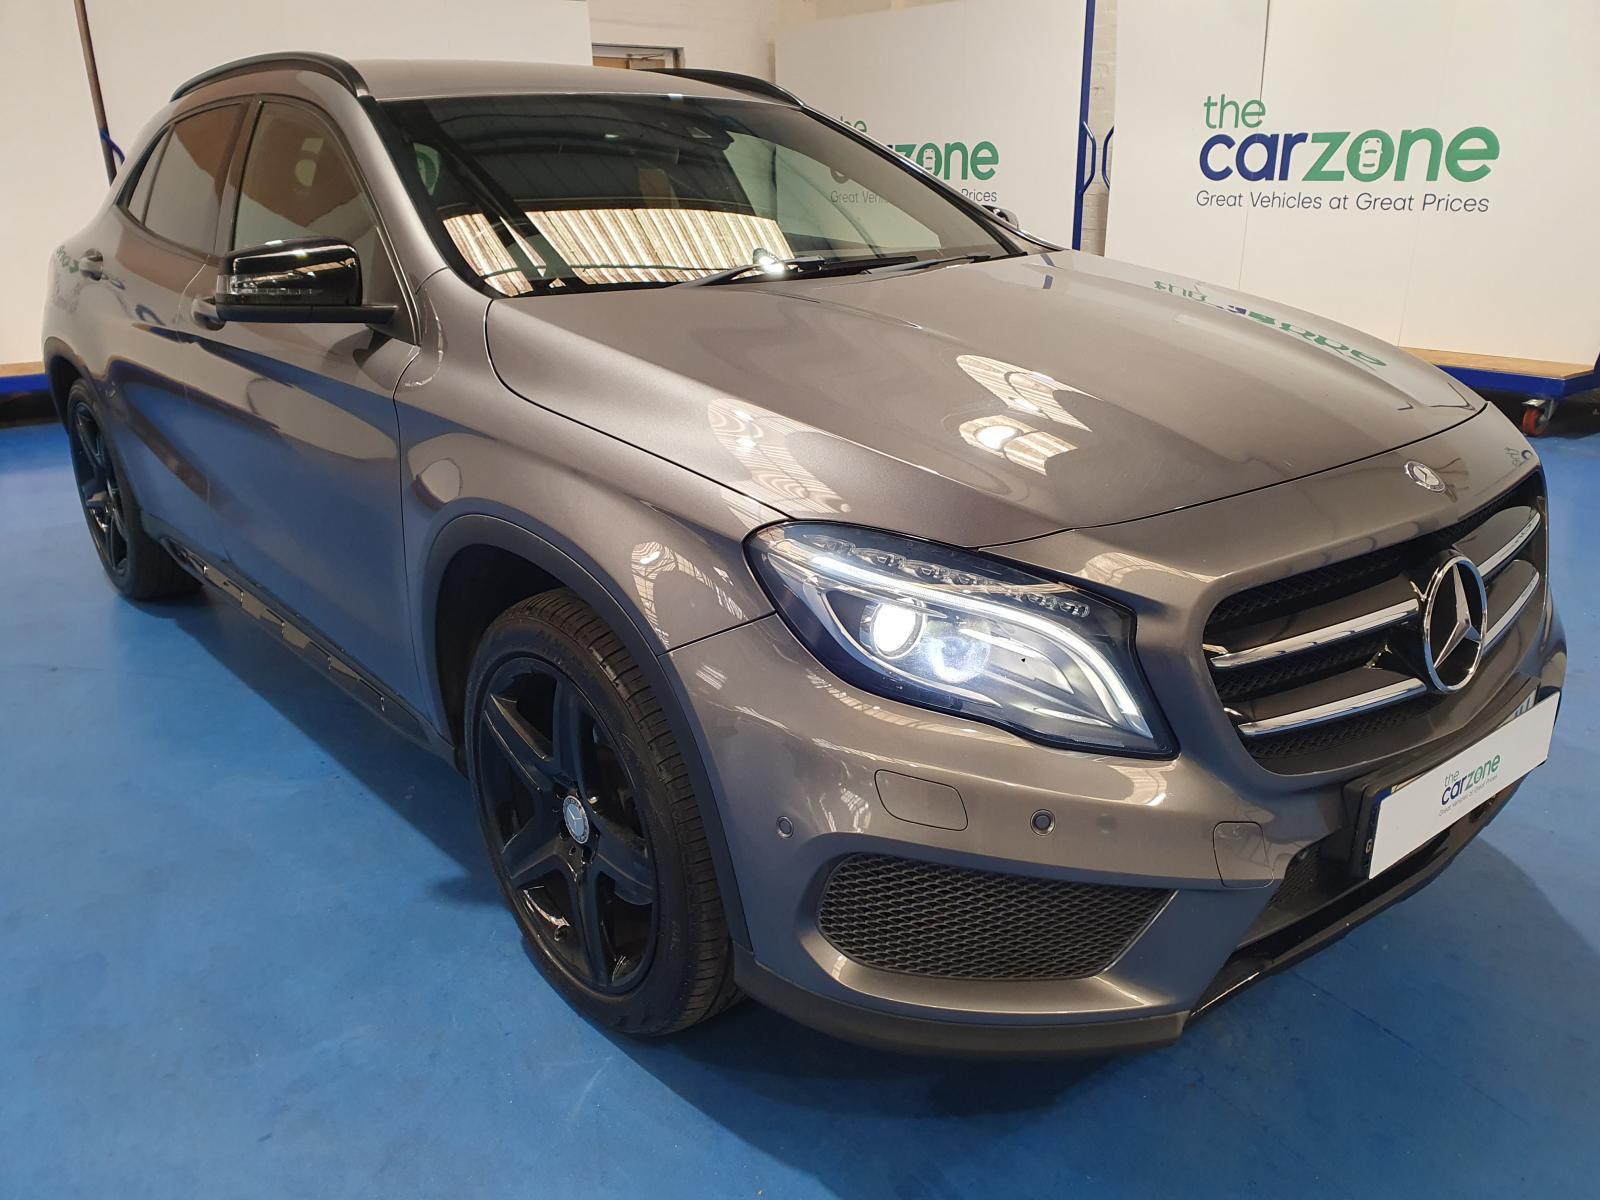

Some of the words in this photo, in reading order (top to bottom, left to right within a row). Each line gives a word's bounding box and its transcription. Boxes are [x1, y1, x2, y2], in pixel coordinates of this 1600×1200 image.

[1203, 94, 1266, 129] the
[1199, 126, 1500, 183] carzone
[1196, 190, 1243, 207] Great
[1250, 191, 1322, 209] Vehicles
[1329, 194, 1349, 210] at
[1356, 192, 1414, 211] Great
[1422, 193, 1489, 212] Prices
[1441, 754, 1501, 806] carzone
